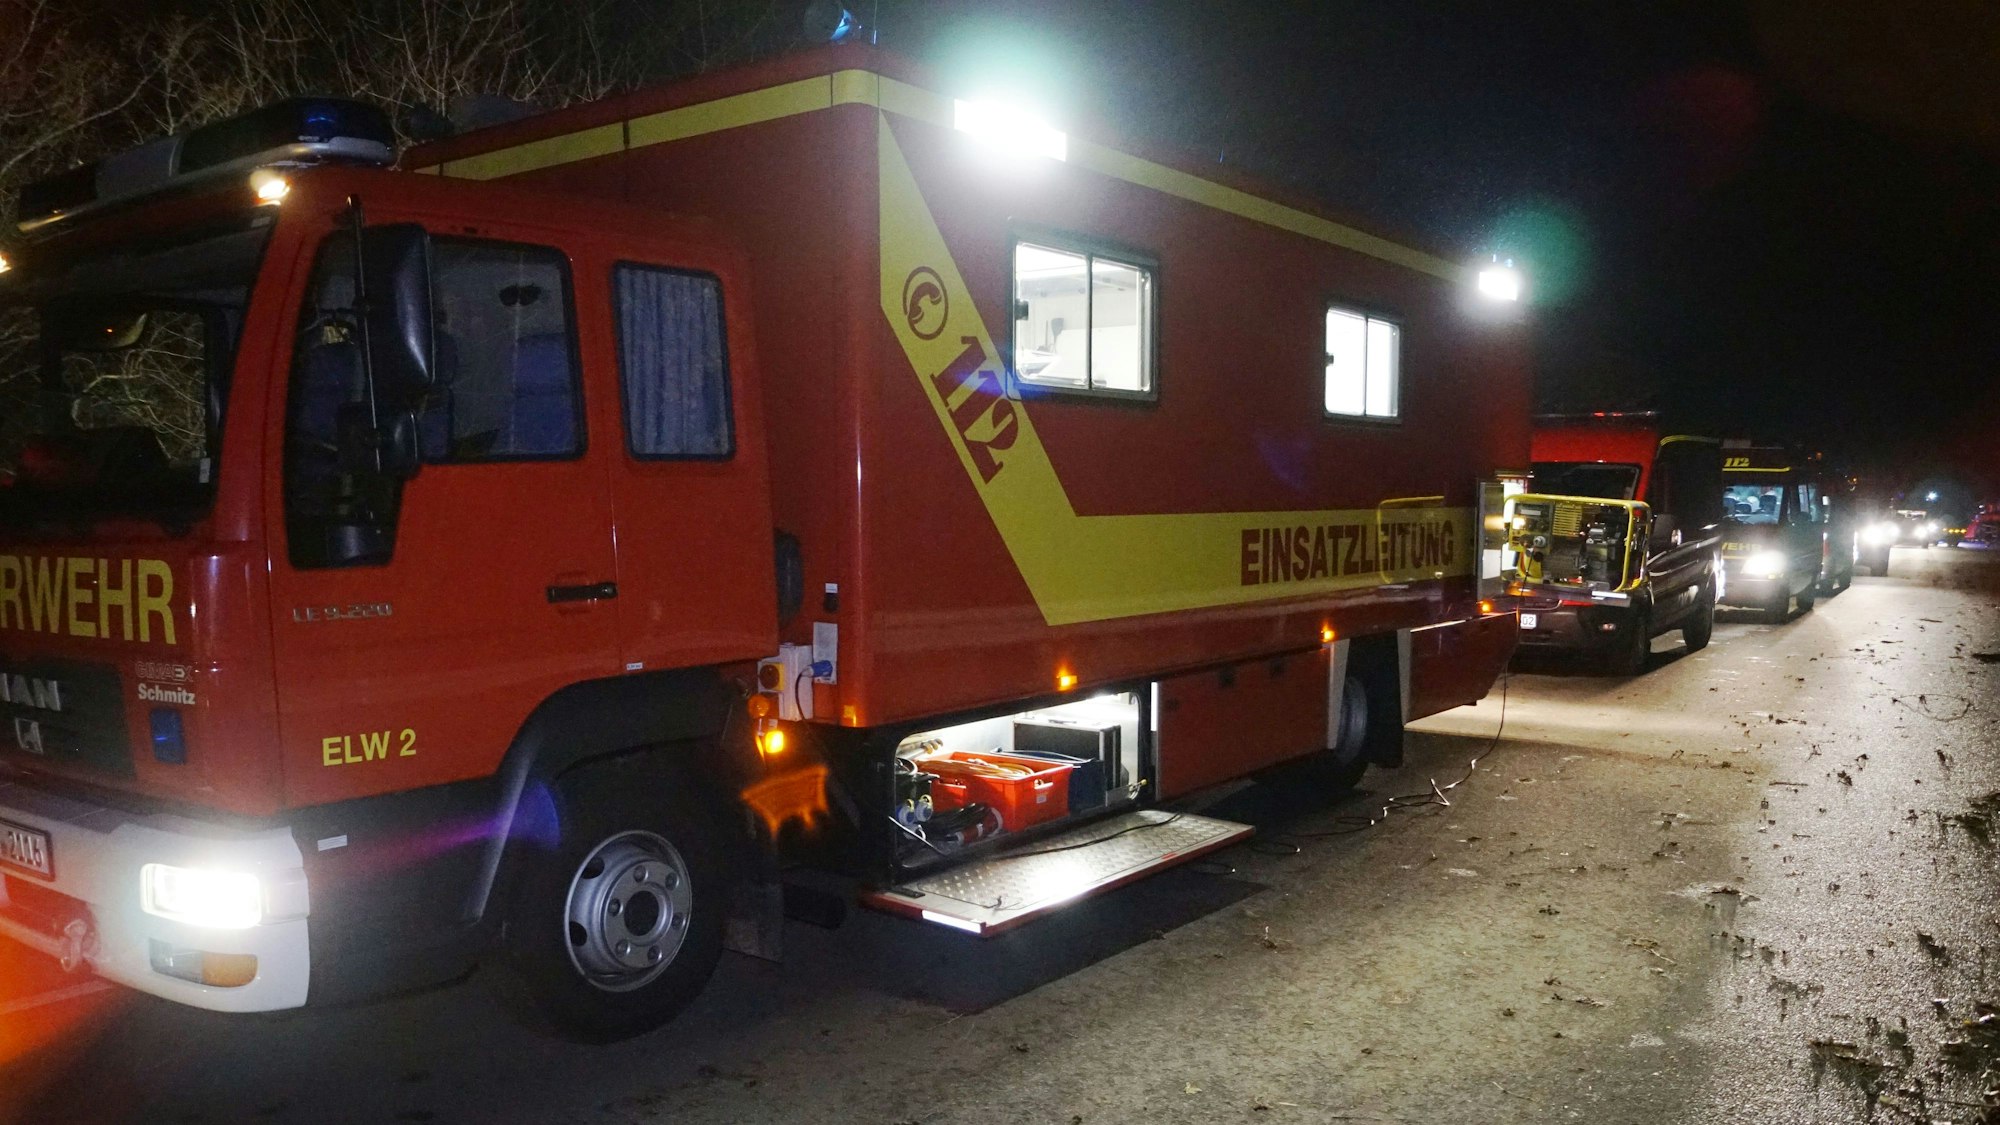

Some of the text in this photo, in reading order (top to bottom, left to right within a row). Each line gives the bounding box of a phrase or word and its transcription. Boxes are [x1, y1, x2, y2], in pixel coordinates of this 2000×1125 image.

[930, 335, 1019, 484] 112
[1724, 457, 1751, 468] 112
[1241, 519, 1454, 586] EINSATZLEITUNG
[0, 554, 176, 645] RWEHR
[138, 683, 196, 705] Schmitz
[322, 728, 417, 767] ELW 2
[8, 830, 45, 868] 2116
